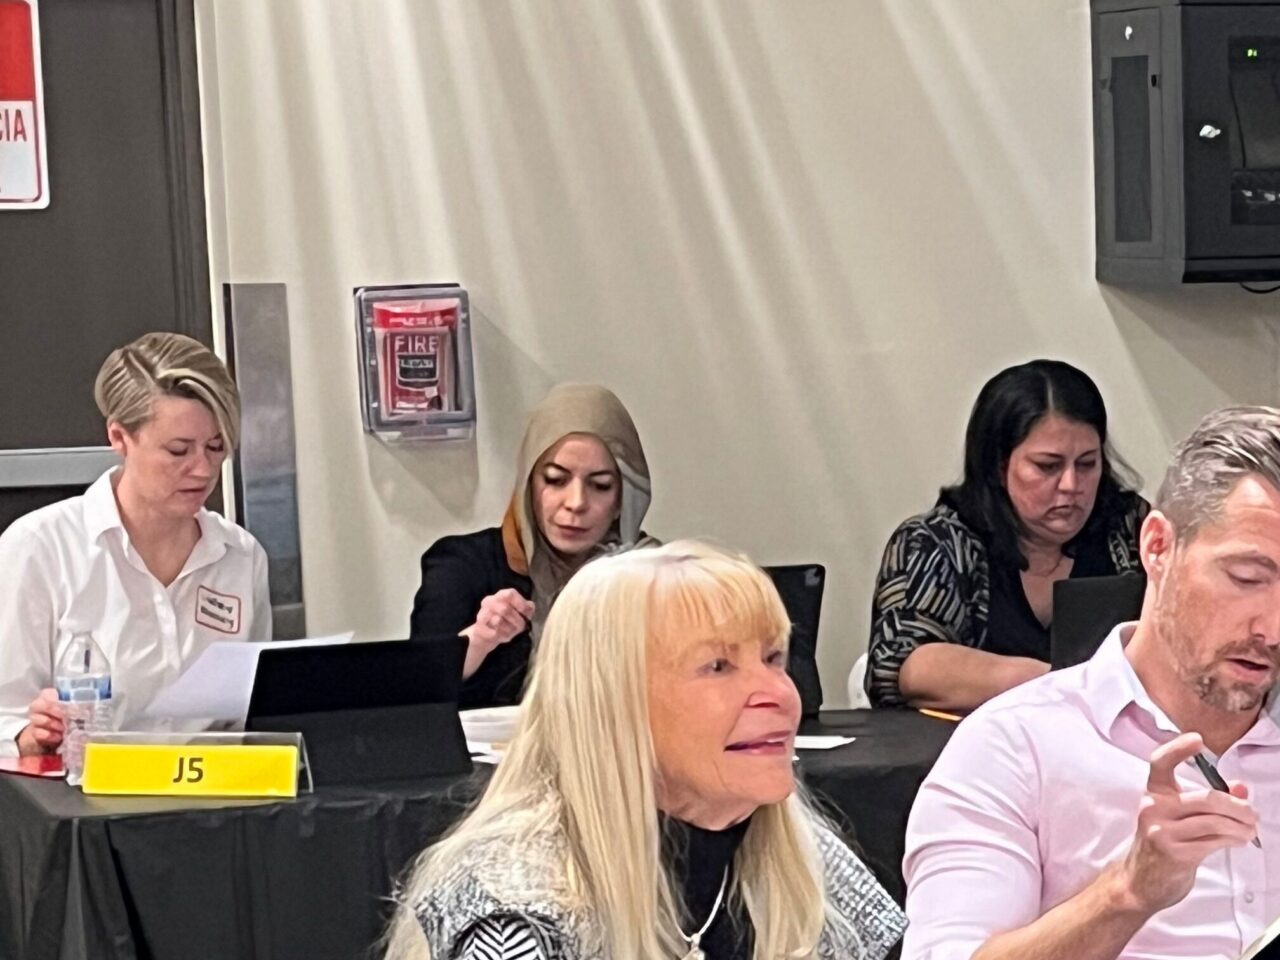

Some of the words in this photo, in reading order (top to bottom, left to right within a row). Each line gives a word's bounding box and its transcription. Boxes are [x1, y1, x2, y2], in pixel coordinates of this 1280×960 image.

[0, 109, 27, 142] IA
[394, 335, 439, 353] FIRE
[173, 757, 203, 783] J5
